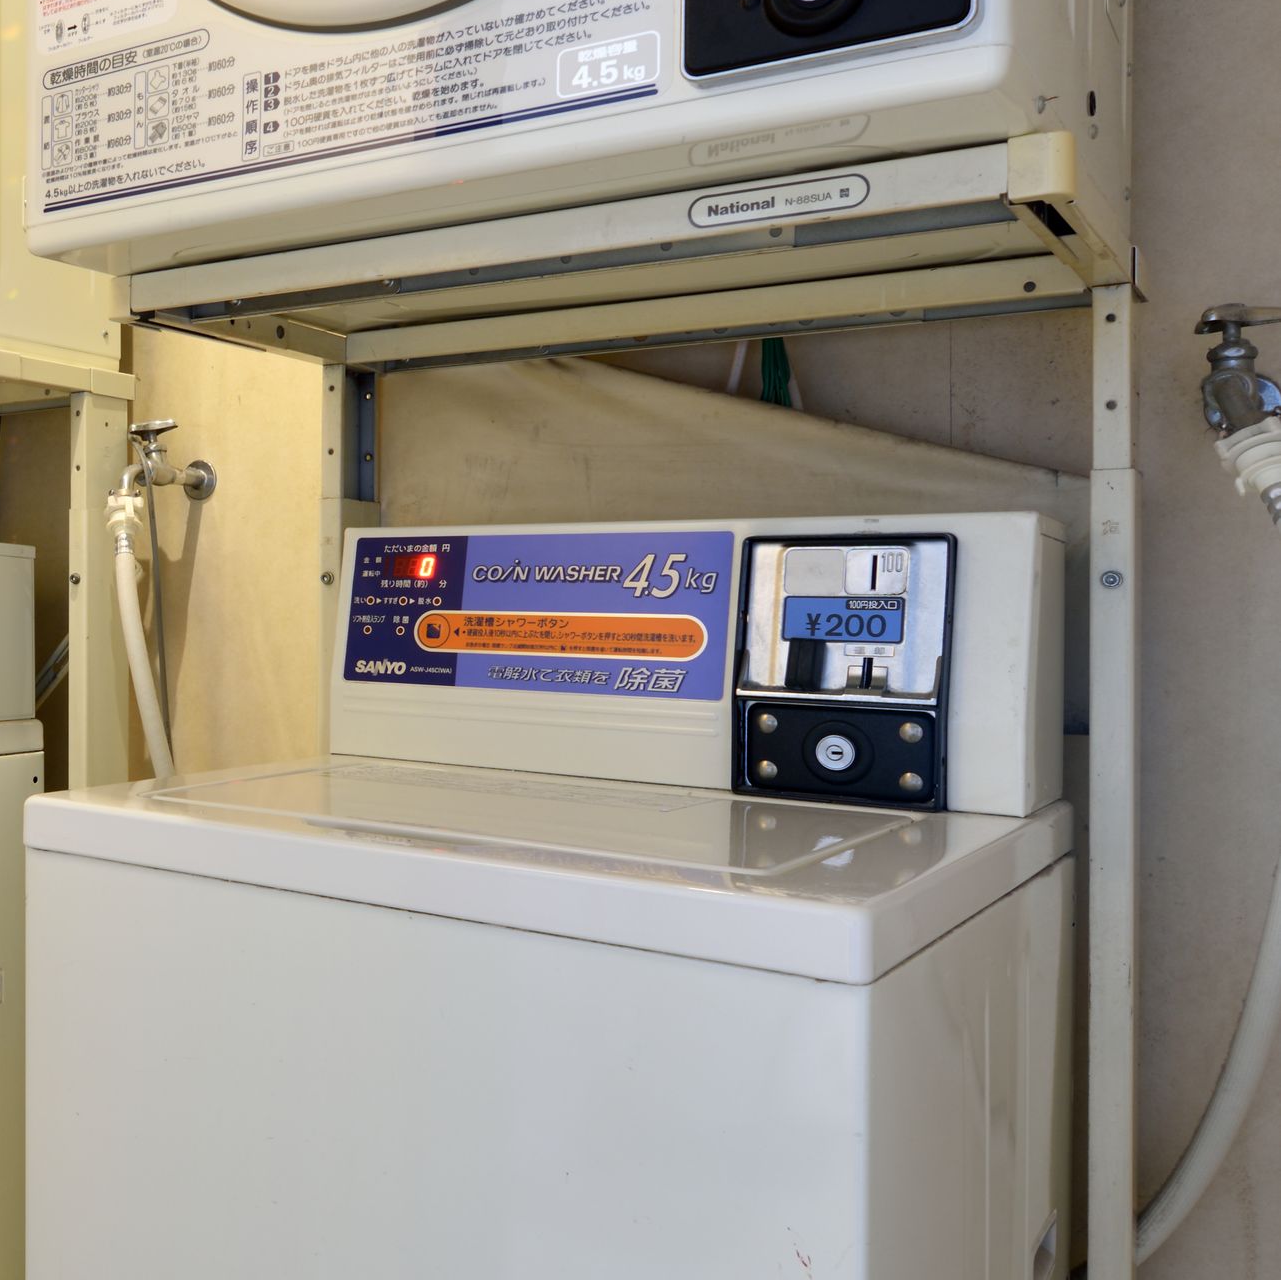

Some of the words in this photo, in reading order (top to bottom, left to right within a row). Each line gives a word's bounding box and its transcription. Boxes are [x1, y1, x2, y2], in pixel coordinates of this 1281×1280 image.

[49, 50, 137, 86] 乾燥時間の目安
[707, 196, 775, 217] National
[785, 191, 832, 206] N-88SUA
[383, 543, 437, 553] ただいまの金額
[441, 543, 451, 553] 円
[418, 556, 435, 577] 0
[881, 552, 904, 573] 100
[439, 579, 447, 589] 分
[534, 564, 622, 584] WASHER
[848, 600, 898, 609] 100円投入口
[463, 615, 570, 630] 洗濯槽シャワーボタン
[805, 613, 887, 638] ¥200
[355, 659, 407, 676] SANYO
[614, 666, 687, 694] 除菌
